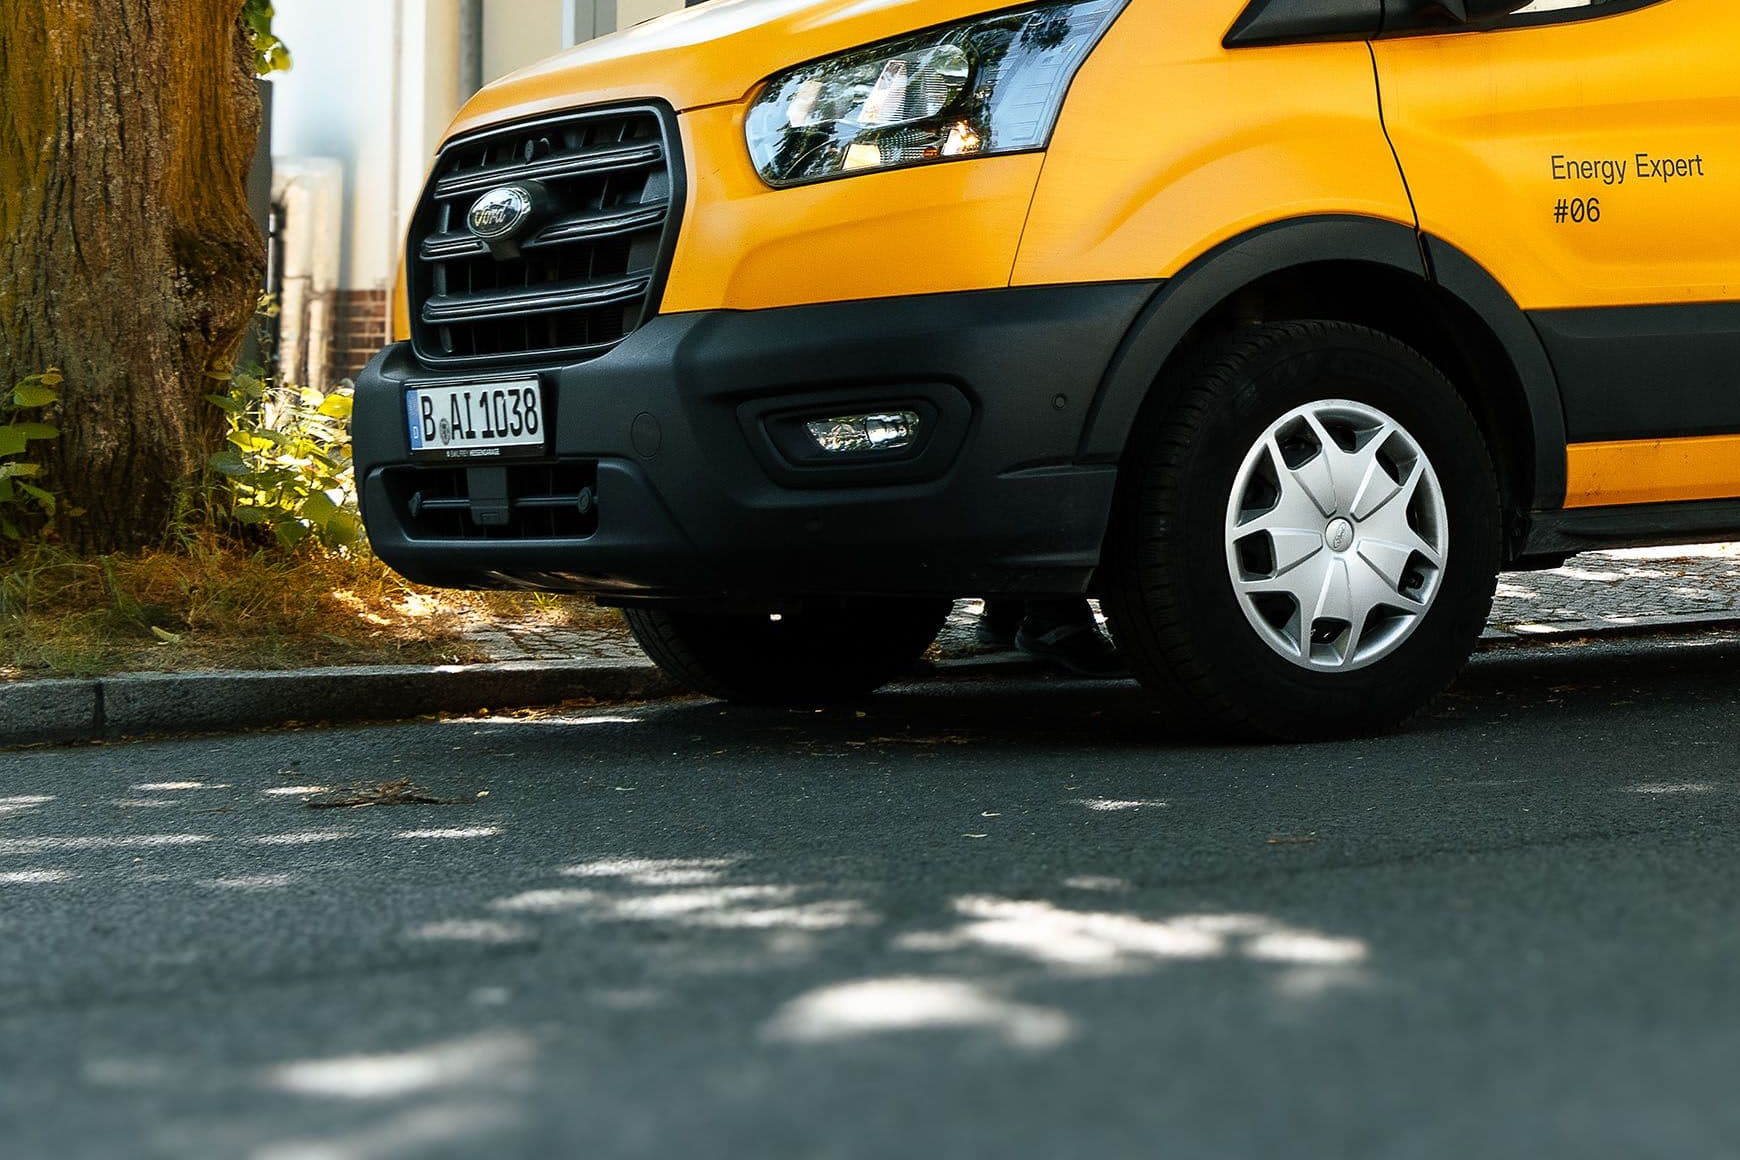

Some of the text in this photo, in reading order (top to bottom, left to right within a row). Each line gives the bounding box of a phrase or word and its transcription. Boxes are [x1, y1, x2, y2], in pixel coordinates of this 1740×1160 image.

[1551, 153, 1704, 185] Energy Expert
[1553, 197, 1601, 224] #06
